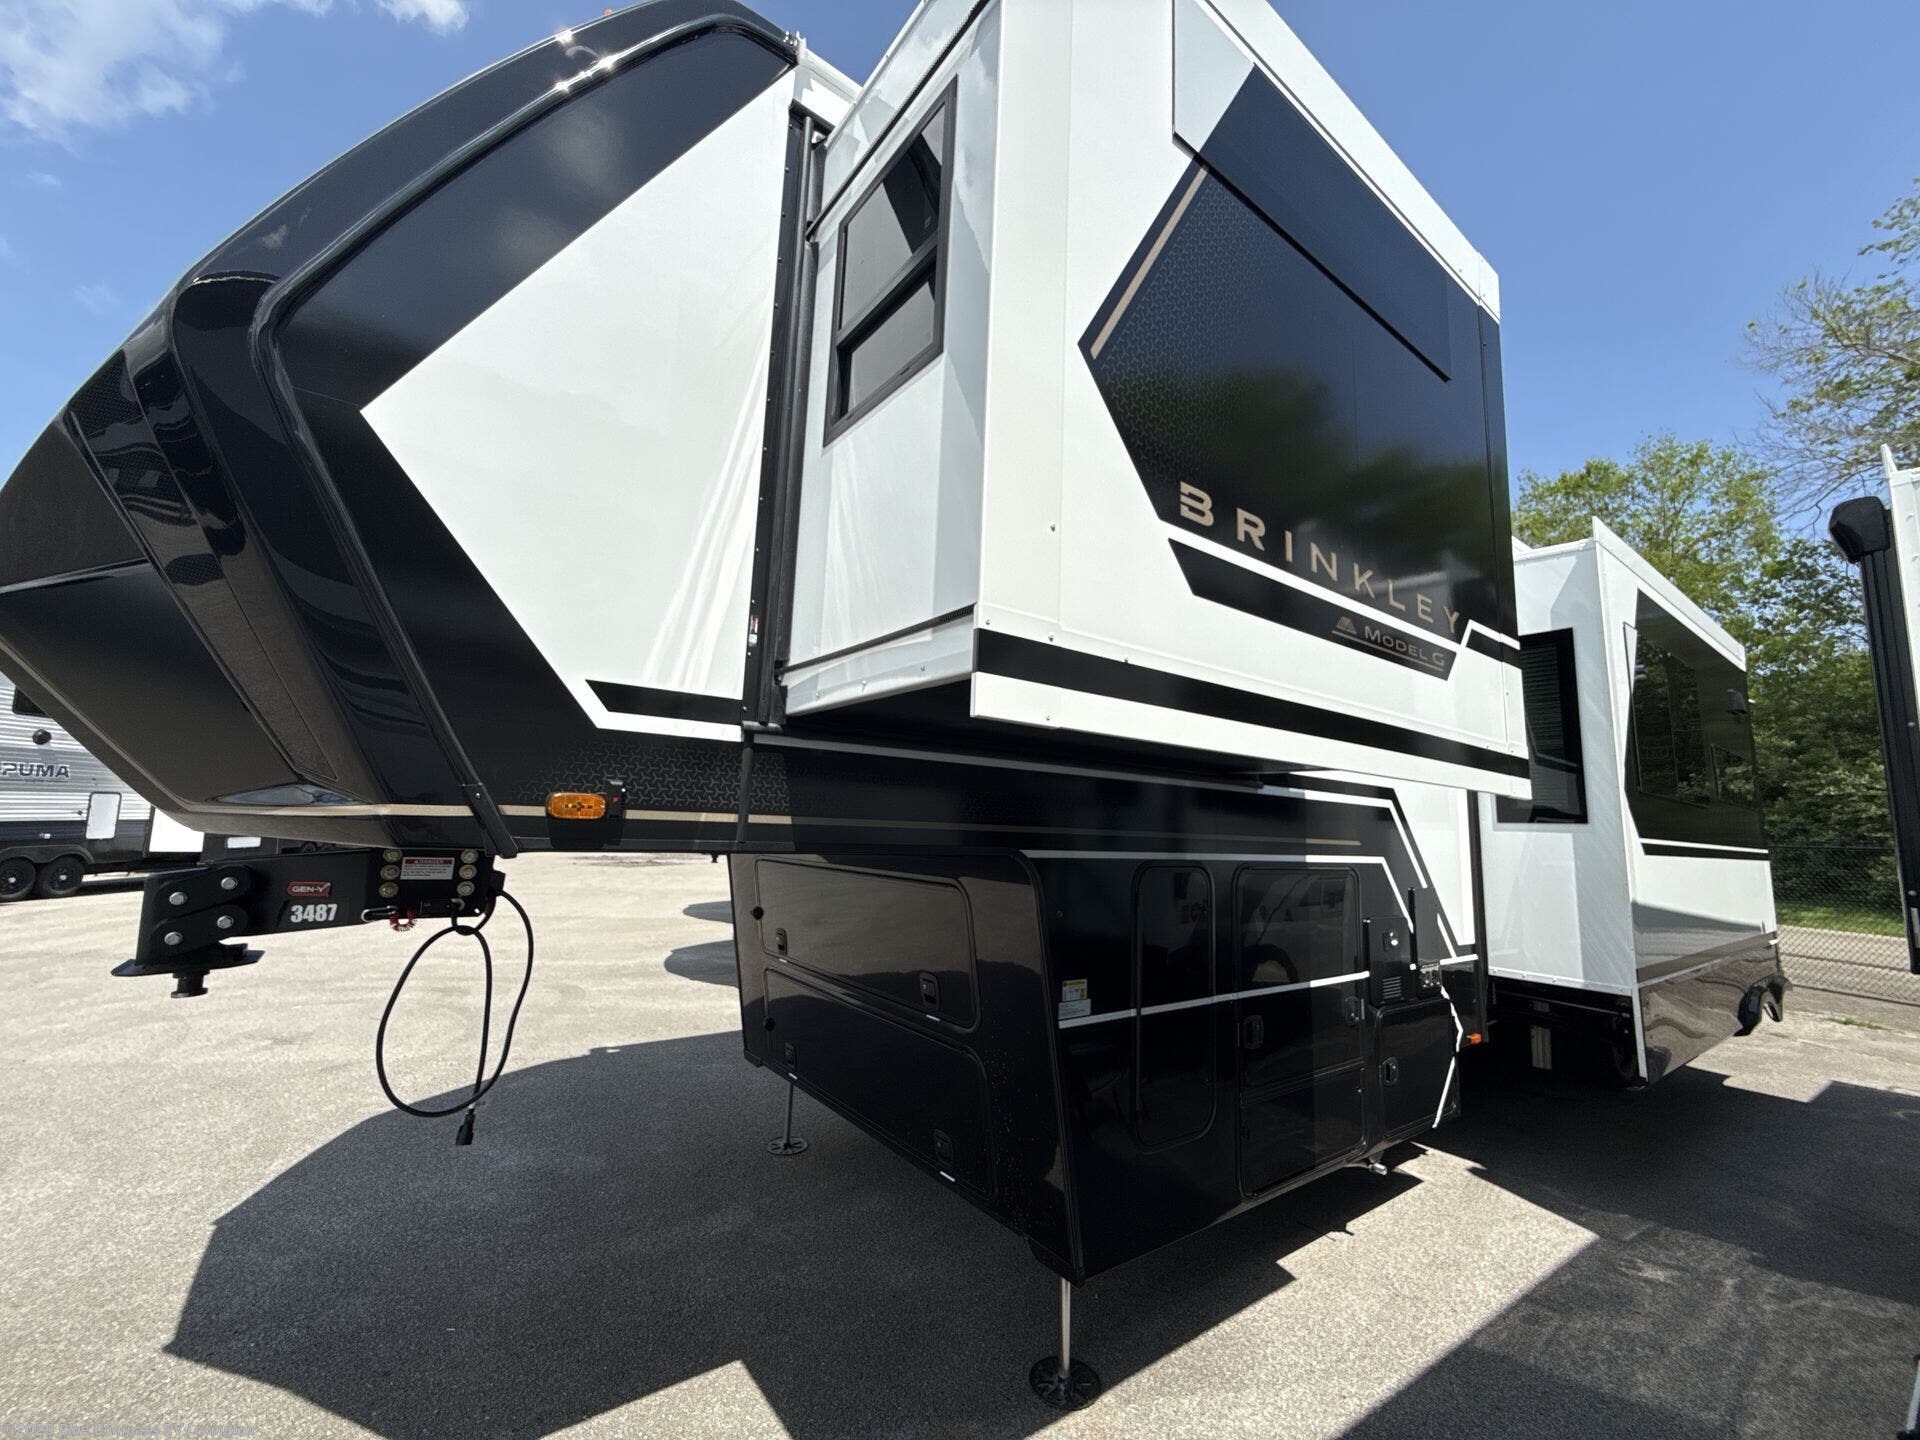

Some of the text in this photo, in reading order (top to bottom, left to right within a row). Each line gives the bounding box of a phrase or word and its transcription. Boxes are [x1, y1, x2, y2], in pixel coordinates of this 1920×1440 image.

[1180, 481, 1460, 634] BRINKLEY
[1364, 625, 1445, 667] MODEL G
[2, 761, 70, 778] PUMA
[291, 882, 332, 893] GEN-Y
[290, 903, 338, 923] 3487
